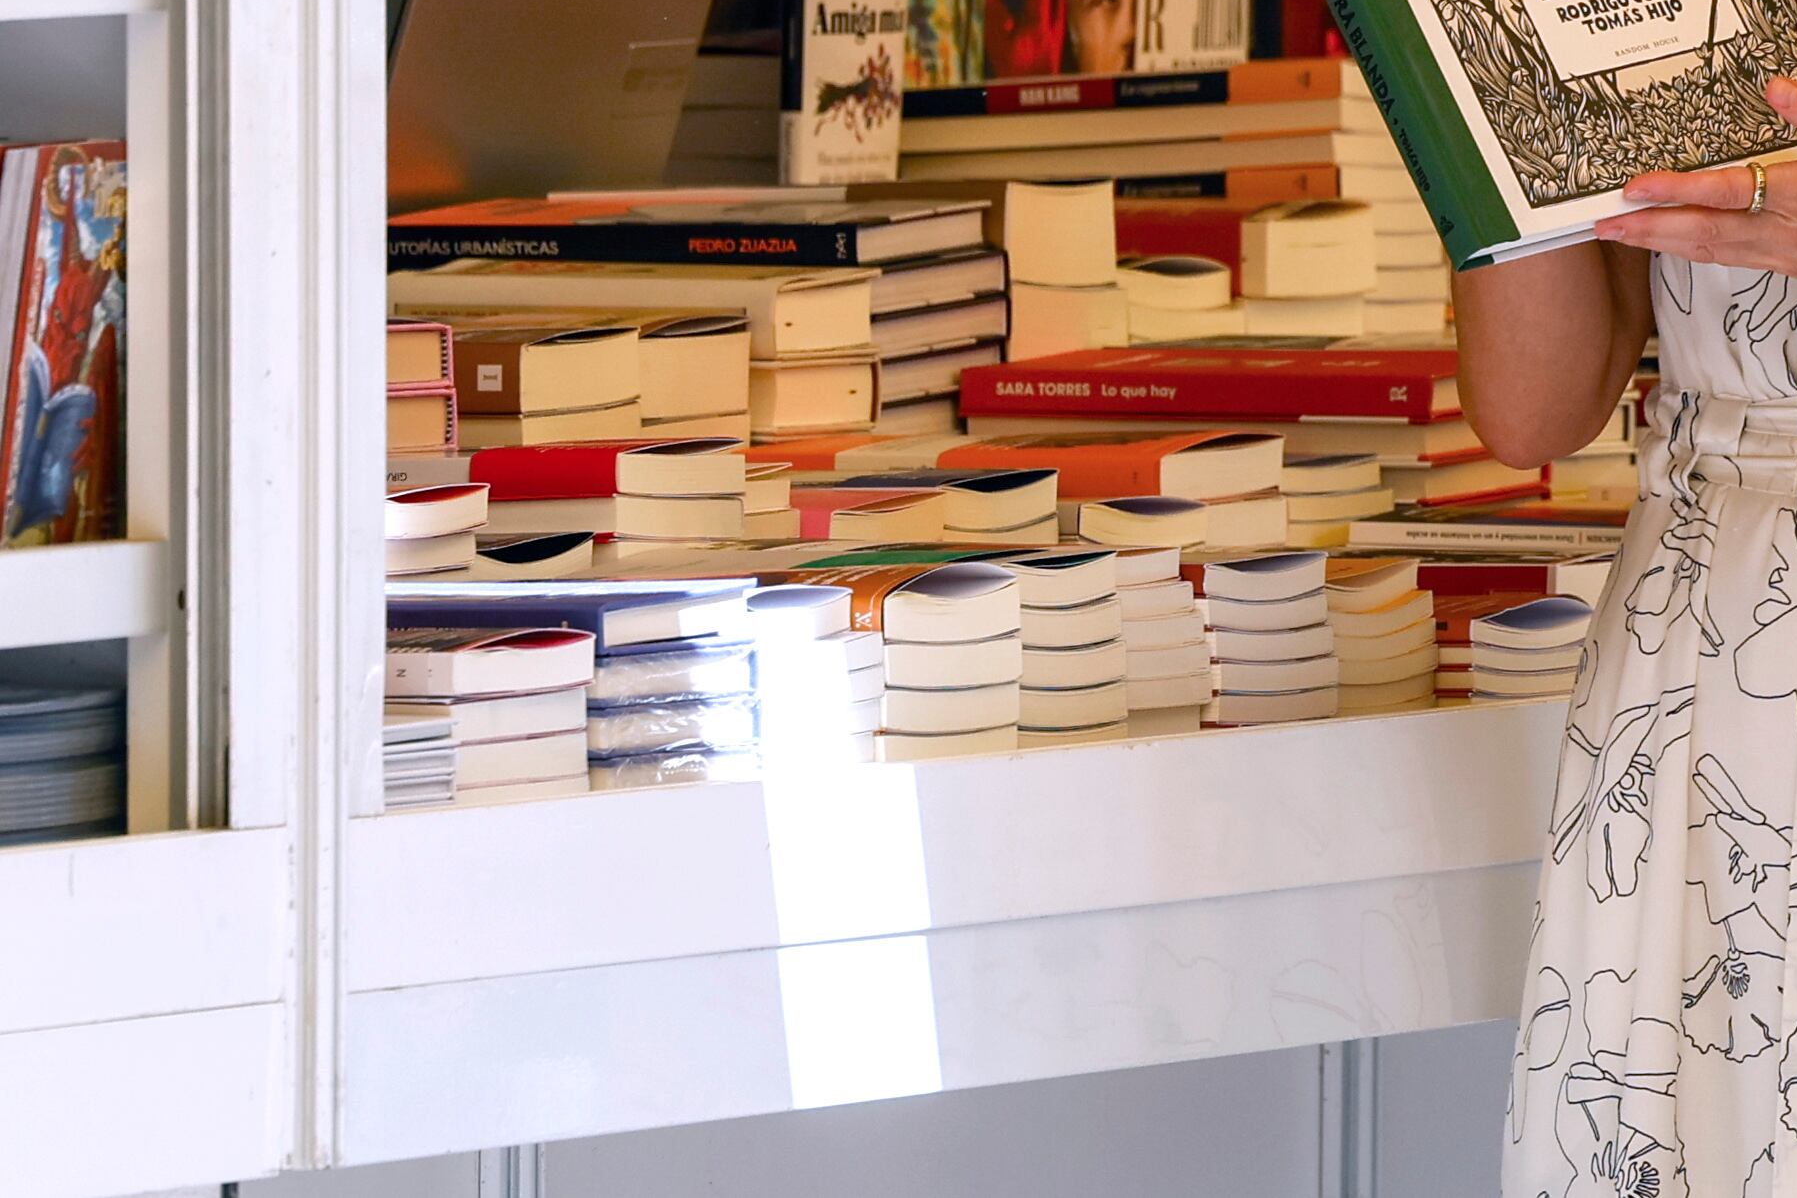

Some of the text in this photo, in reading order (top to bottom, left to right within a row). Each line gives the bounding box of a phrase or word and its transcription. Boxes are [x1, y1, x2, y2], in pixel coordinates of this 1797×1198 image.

[812, 2, 876, 45] Amiga
[1582, 0, 1683, 35] TOMÁS HIJO
[1615, 36, 1679, 57] RANDOM HOUSE
[1350, 27, 1395, 116] BLANDA
[389, 237, 559, 256] UTOPÍAS URBANÍSTICAS
[688, 237, 798, 254] PEDRO ZUAZUA
[996, 382, 1177, 400] SARA TORRES Lo que hay
